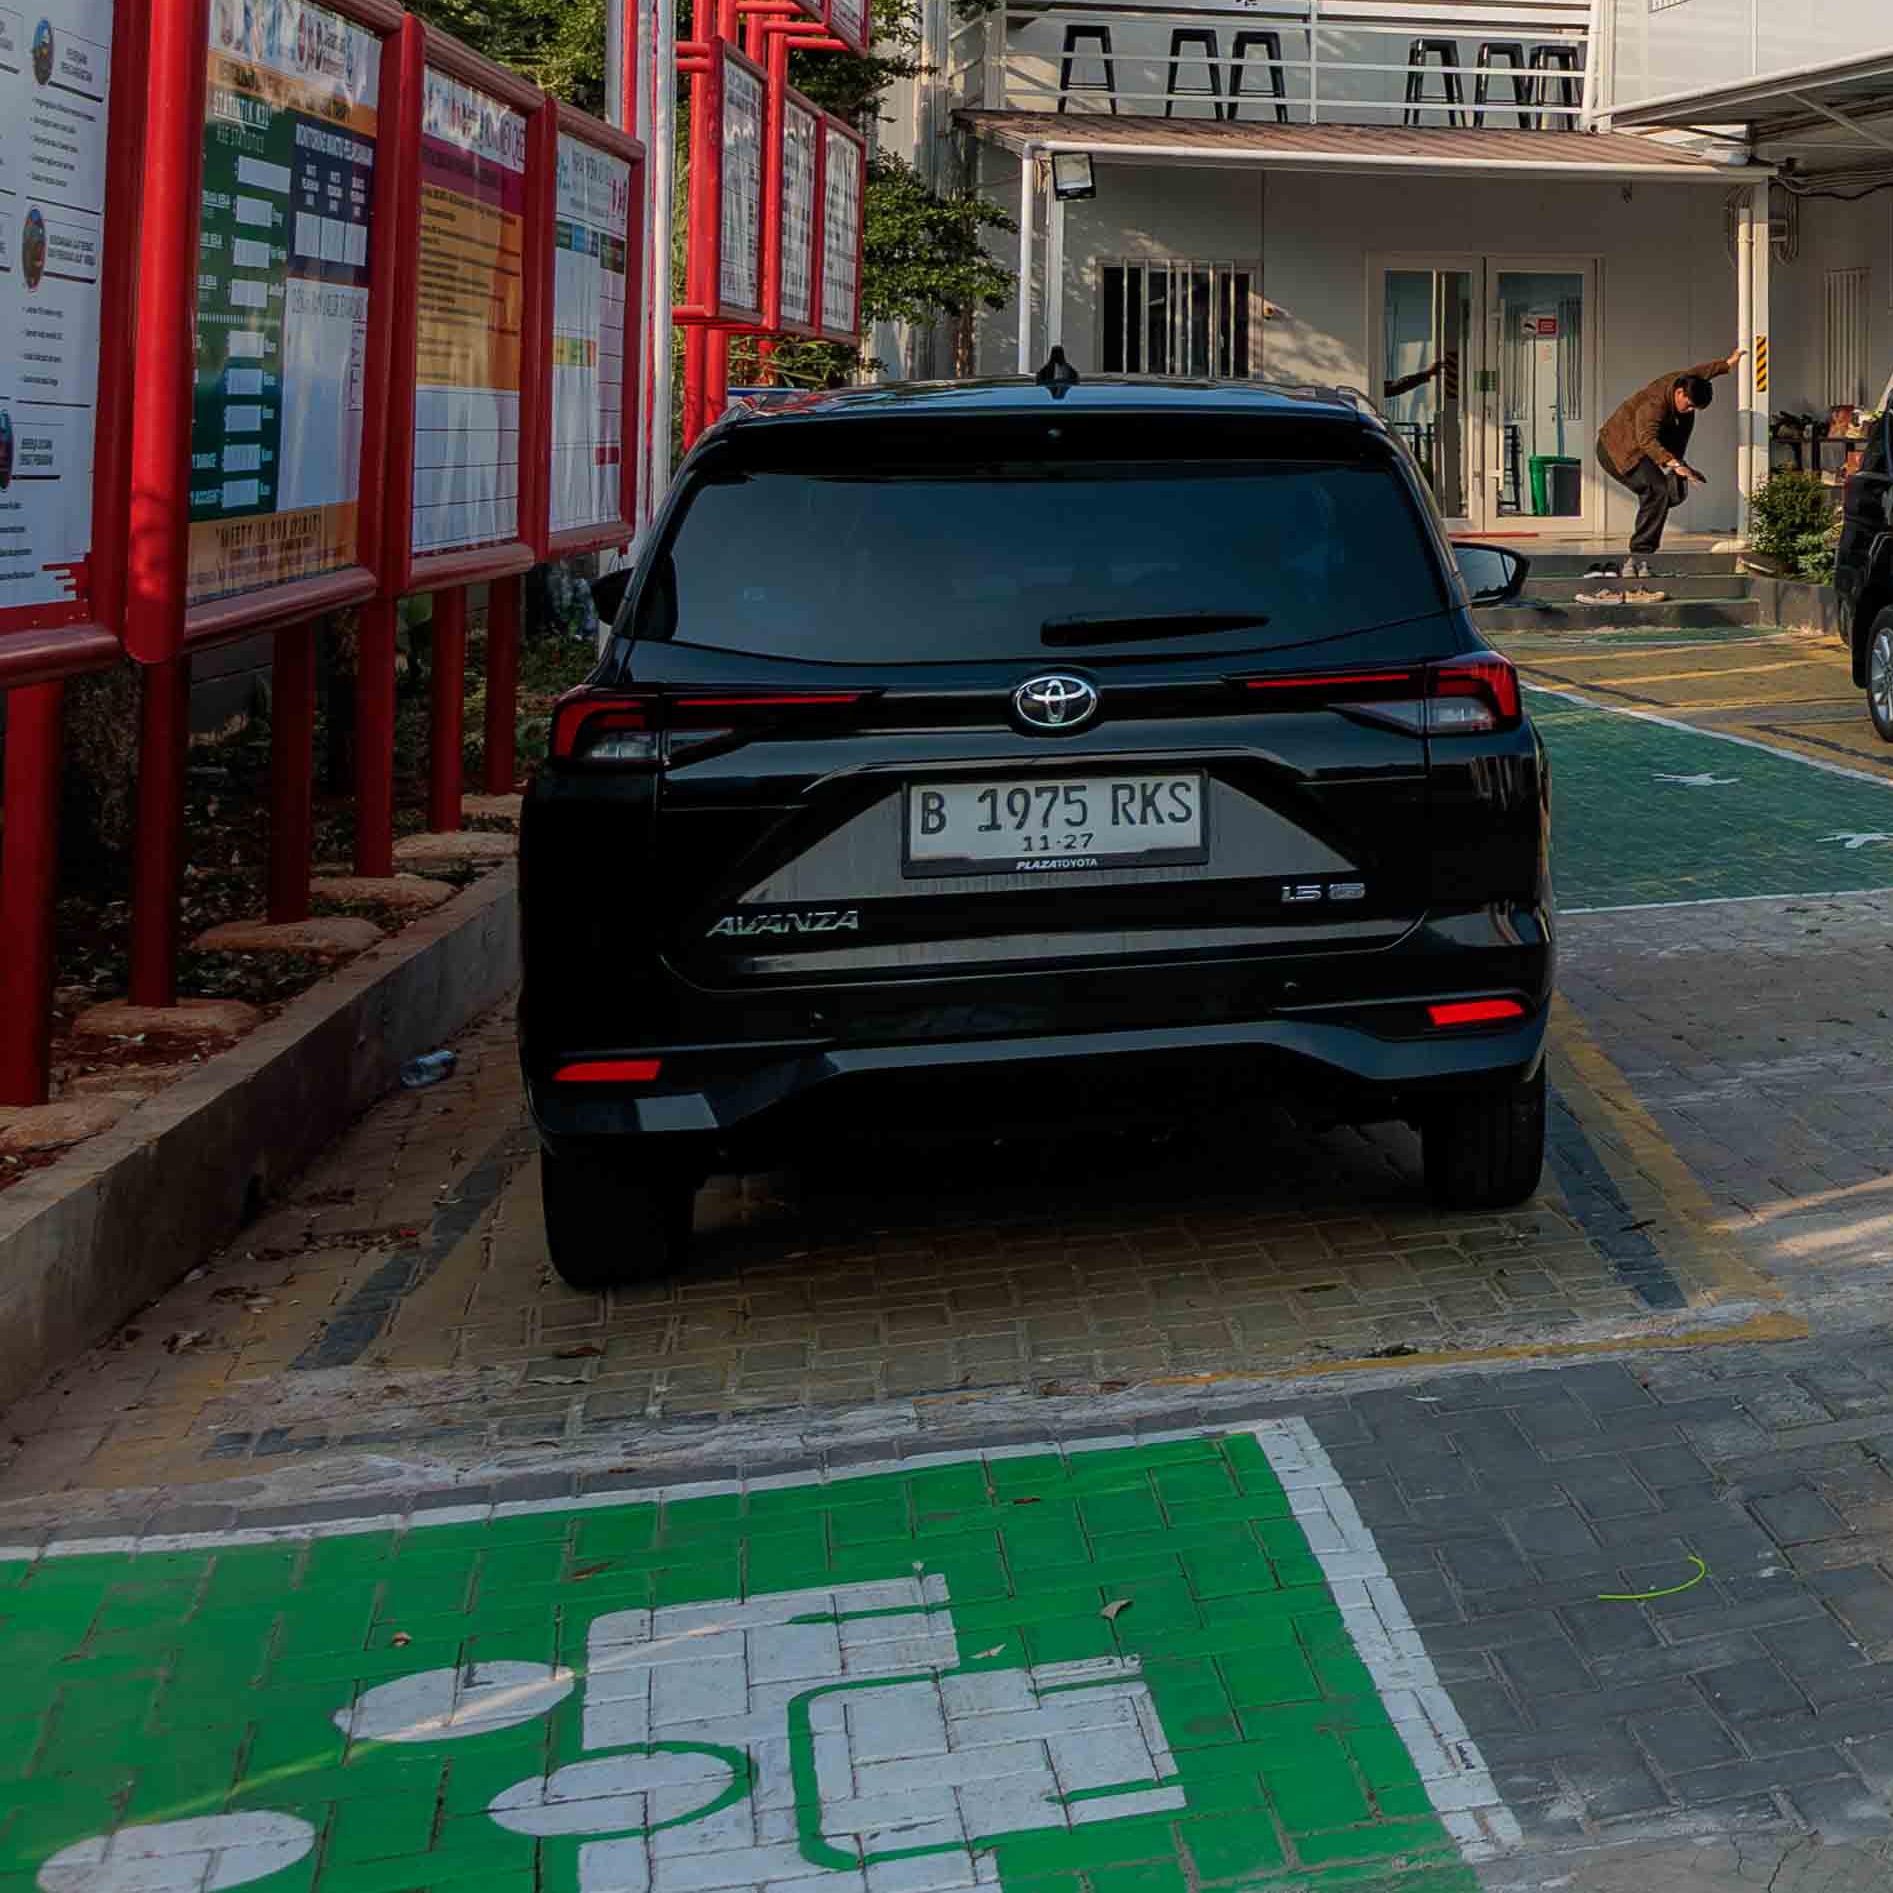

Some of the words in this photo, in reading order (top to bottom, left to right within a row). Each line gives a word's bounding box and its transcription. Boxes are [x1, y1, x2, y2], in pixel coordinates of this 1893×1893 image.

[920, 791, 947, 835] B
[977, 785, 1088, 832] 1975
[1111, 782, 1193, 826] RKS
[705, 911, 859, 937] AVANZA
